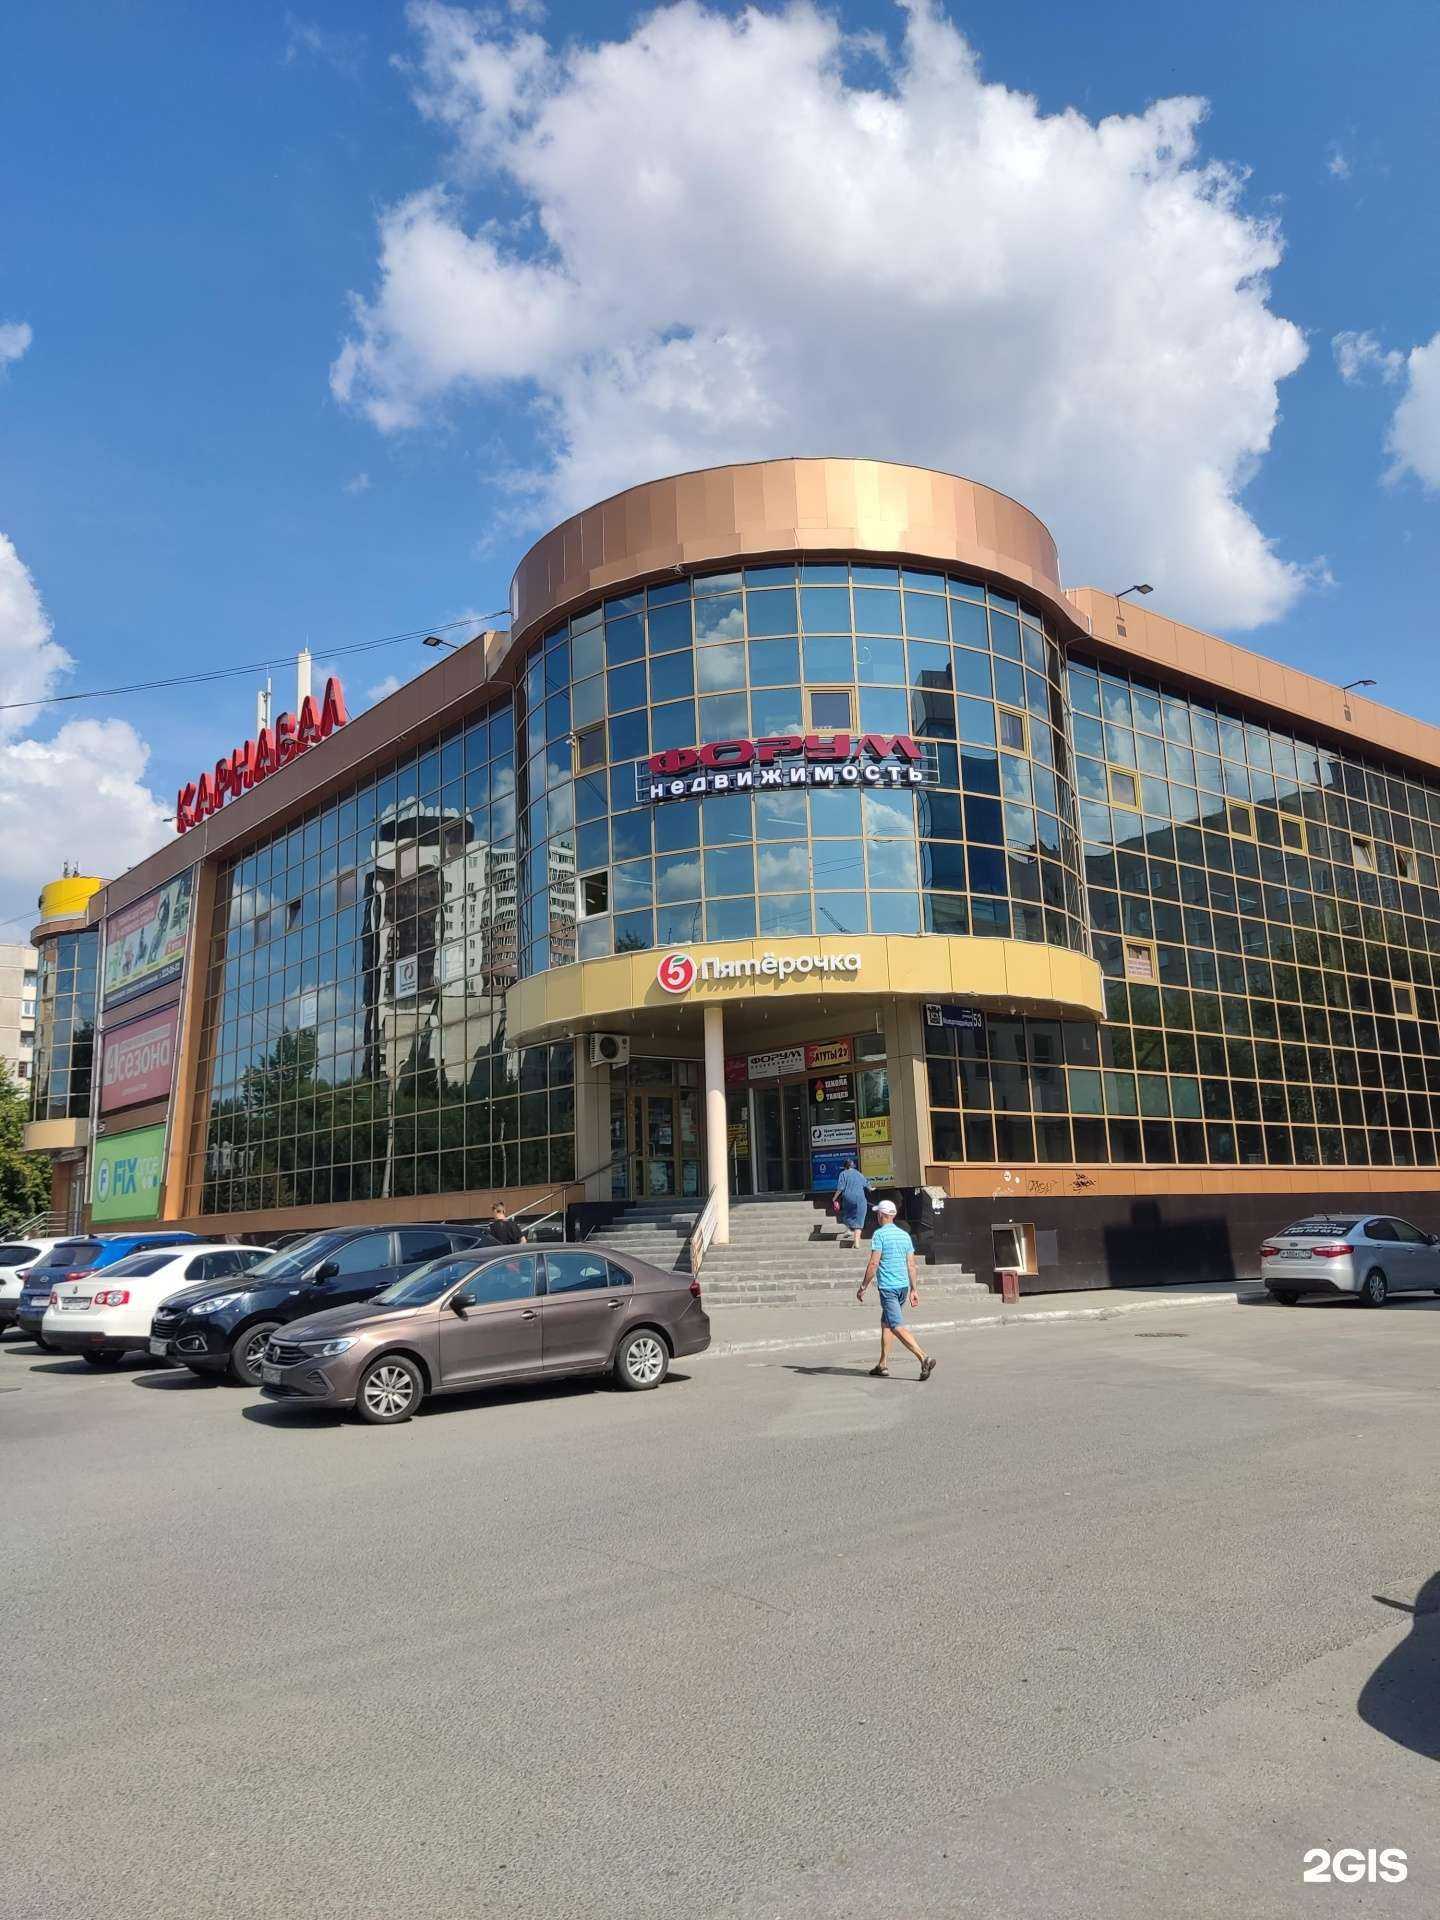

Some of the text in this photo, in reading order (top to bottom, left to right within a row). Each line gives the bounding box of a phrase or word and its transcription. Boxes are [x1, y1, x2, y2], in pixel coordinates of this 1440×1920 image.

[177, 677, 347, 834] КАРНАВАЛ
[648, 734, 923, 775] ФОРУМ
[650, 764, 923, 799] недвижимость
[701, 952, 862, 980] Пятёрочка
[750, 1050, 802, 1065] ФОРУМ
[112, 1156, 138, 1196] FIX
